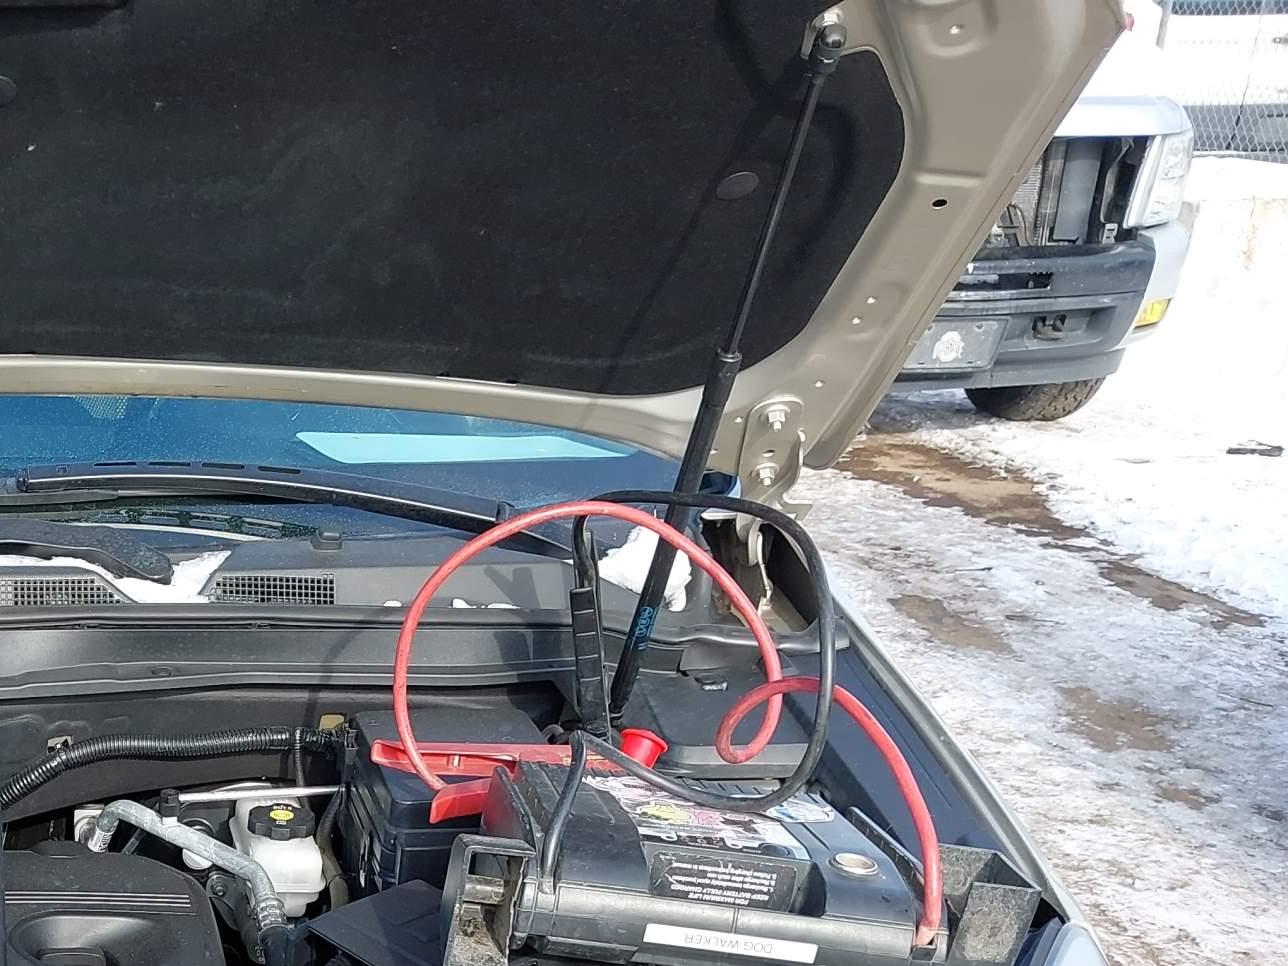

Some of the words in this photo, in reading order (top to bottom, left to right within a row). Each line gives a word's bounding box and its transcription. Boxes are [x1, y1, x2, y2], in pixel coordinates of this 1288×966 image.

[671, 883, 703, 893] CHARGED
[702, 887, 723, 895] FULLY
[688, 892, 703, 900] LIFE
[702, 894, 735, 904] MAXIMUM
[721, 889, 752, 899] BATTERY
[734, 898, 750, 906] FOR
[685, 932, 739, 950] WALKER
[743, 941, 773, 954] DOG
